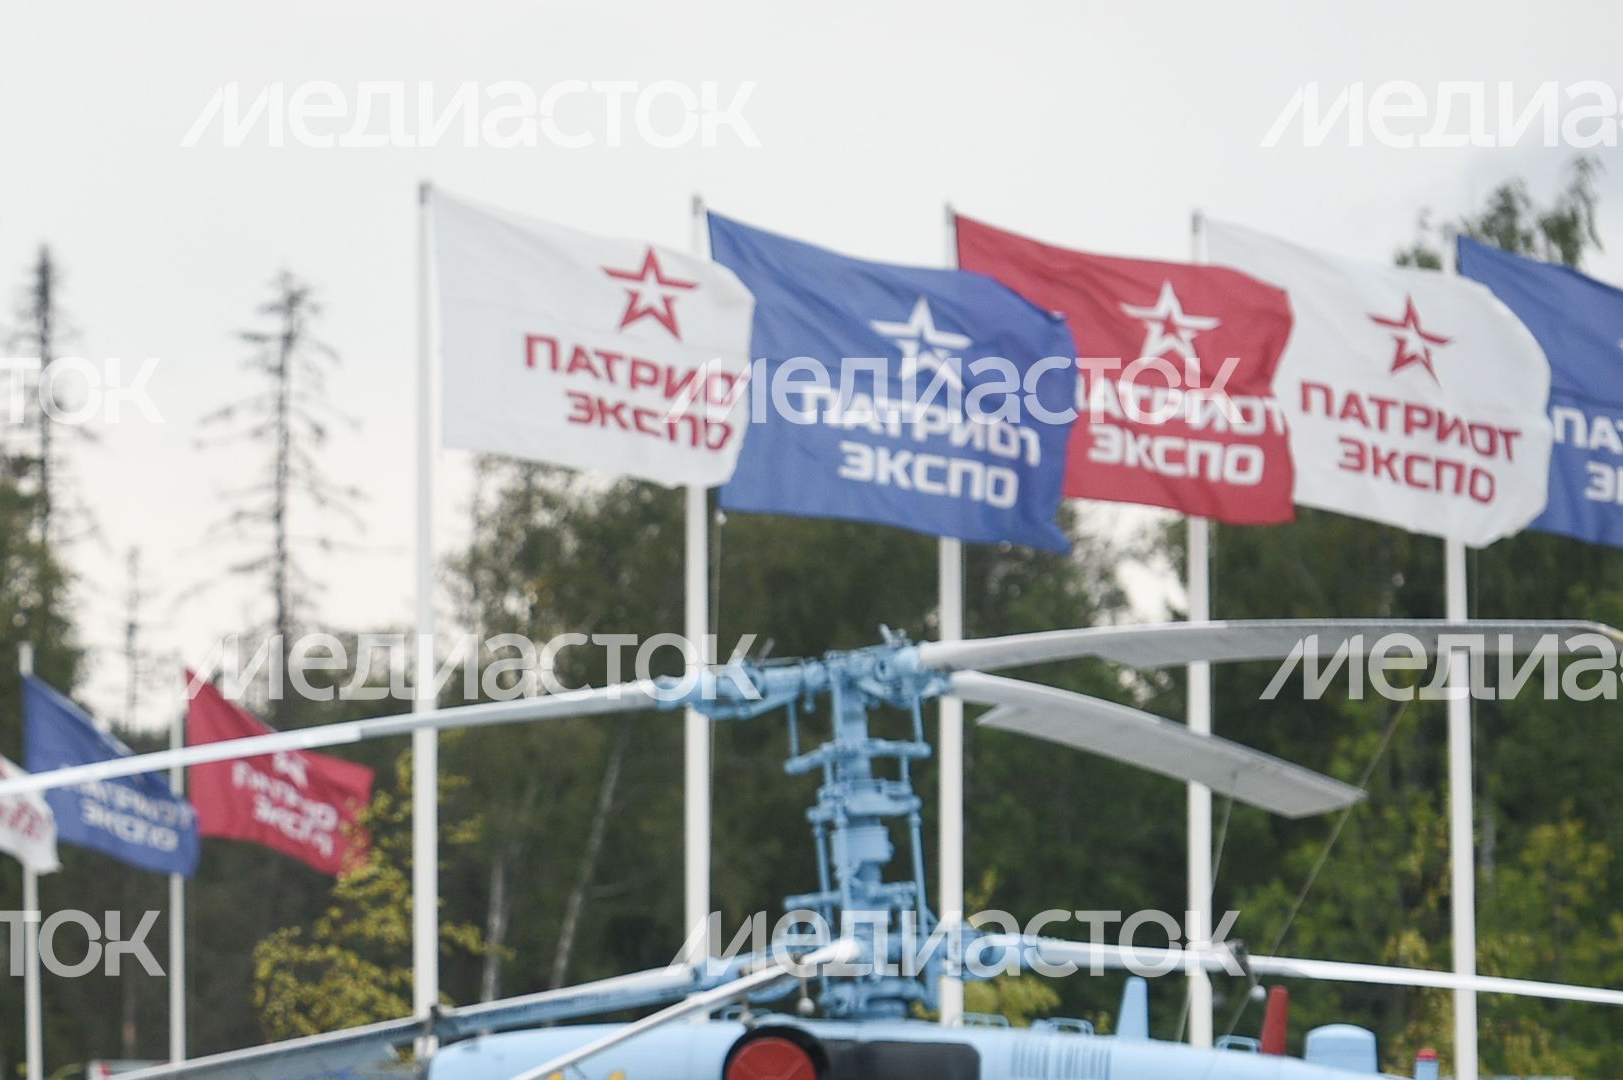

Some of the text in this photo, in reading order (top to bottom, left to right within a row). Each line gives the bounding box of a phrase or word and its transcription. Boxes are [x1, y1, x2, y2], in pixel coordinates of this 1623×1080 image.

[523, 333, 749, 405] ПАТРИО
[566, 390, 734, 453] ЭКСПО
[1087, 422, 1266, 486] ЭКСПО
[1300, 381, 1524, 463] ПАТРИОТ
[838, 441, 1019, 508] ЭКСПО
[1338, 437, 1496, 504] ЭКСПО
